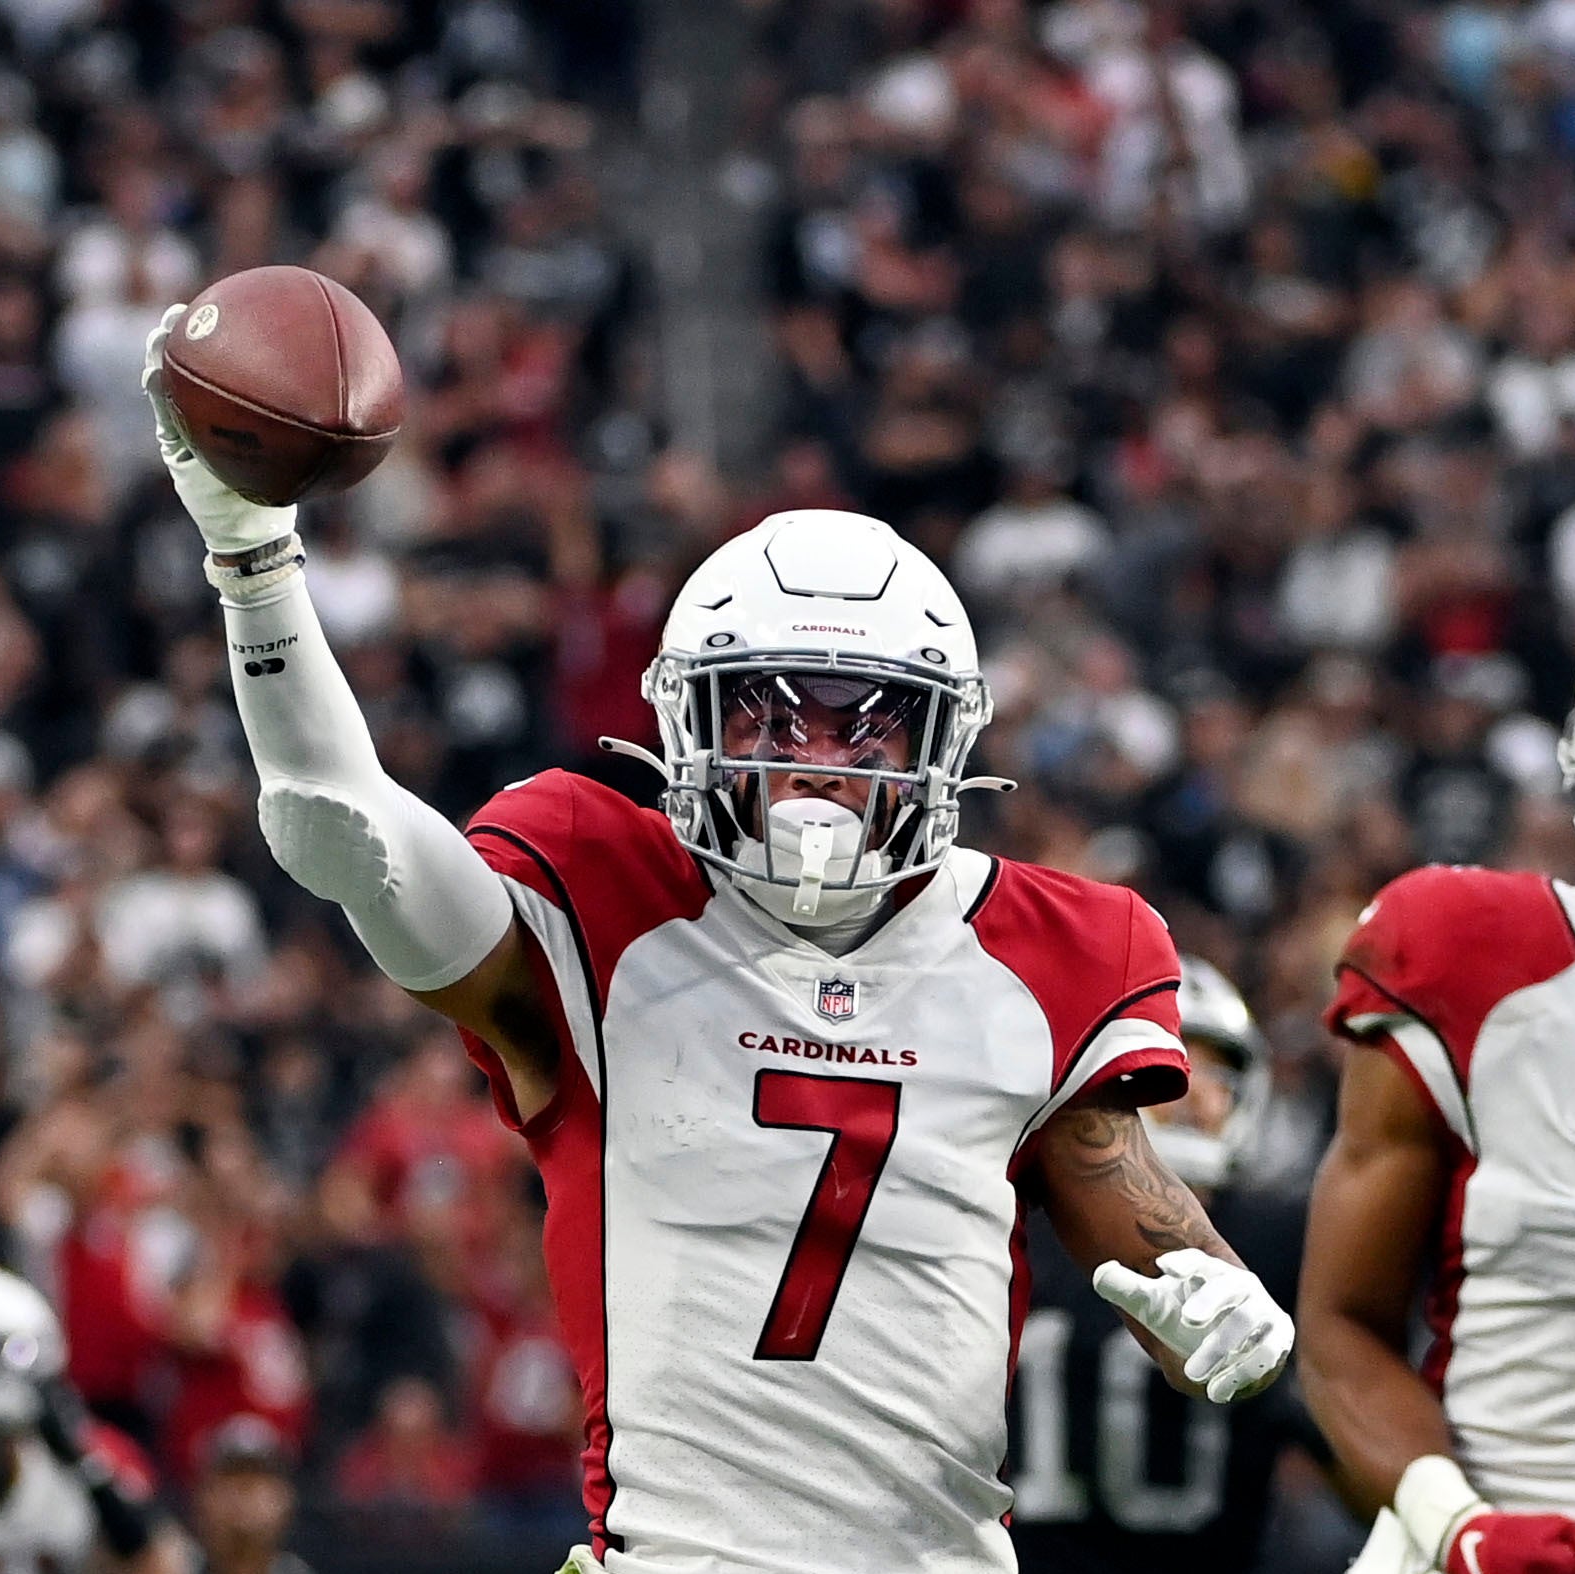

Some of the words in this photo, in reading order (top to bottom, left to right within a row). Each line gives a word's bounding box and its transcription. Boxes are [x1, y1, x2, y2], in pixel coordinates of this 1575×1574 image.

[792, 624, 866, 637] CARDINALS
[822, 995, 850, 1015] NFL
[738, 1031, 919, 1067] CARDINALS
[752, 1067, 903, 1362] 7
